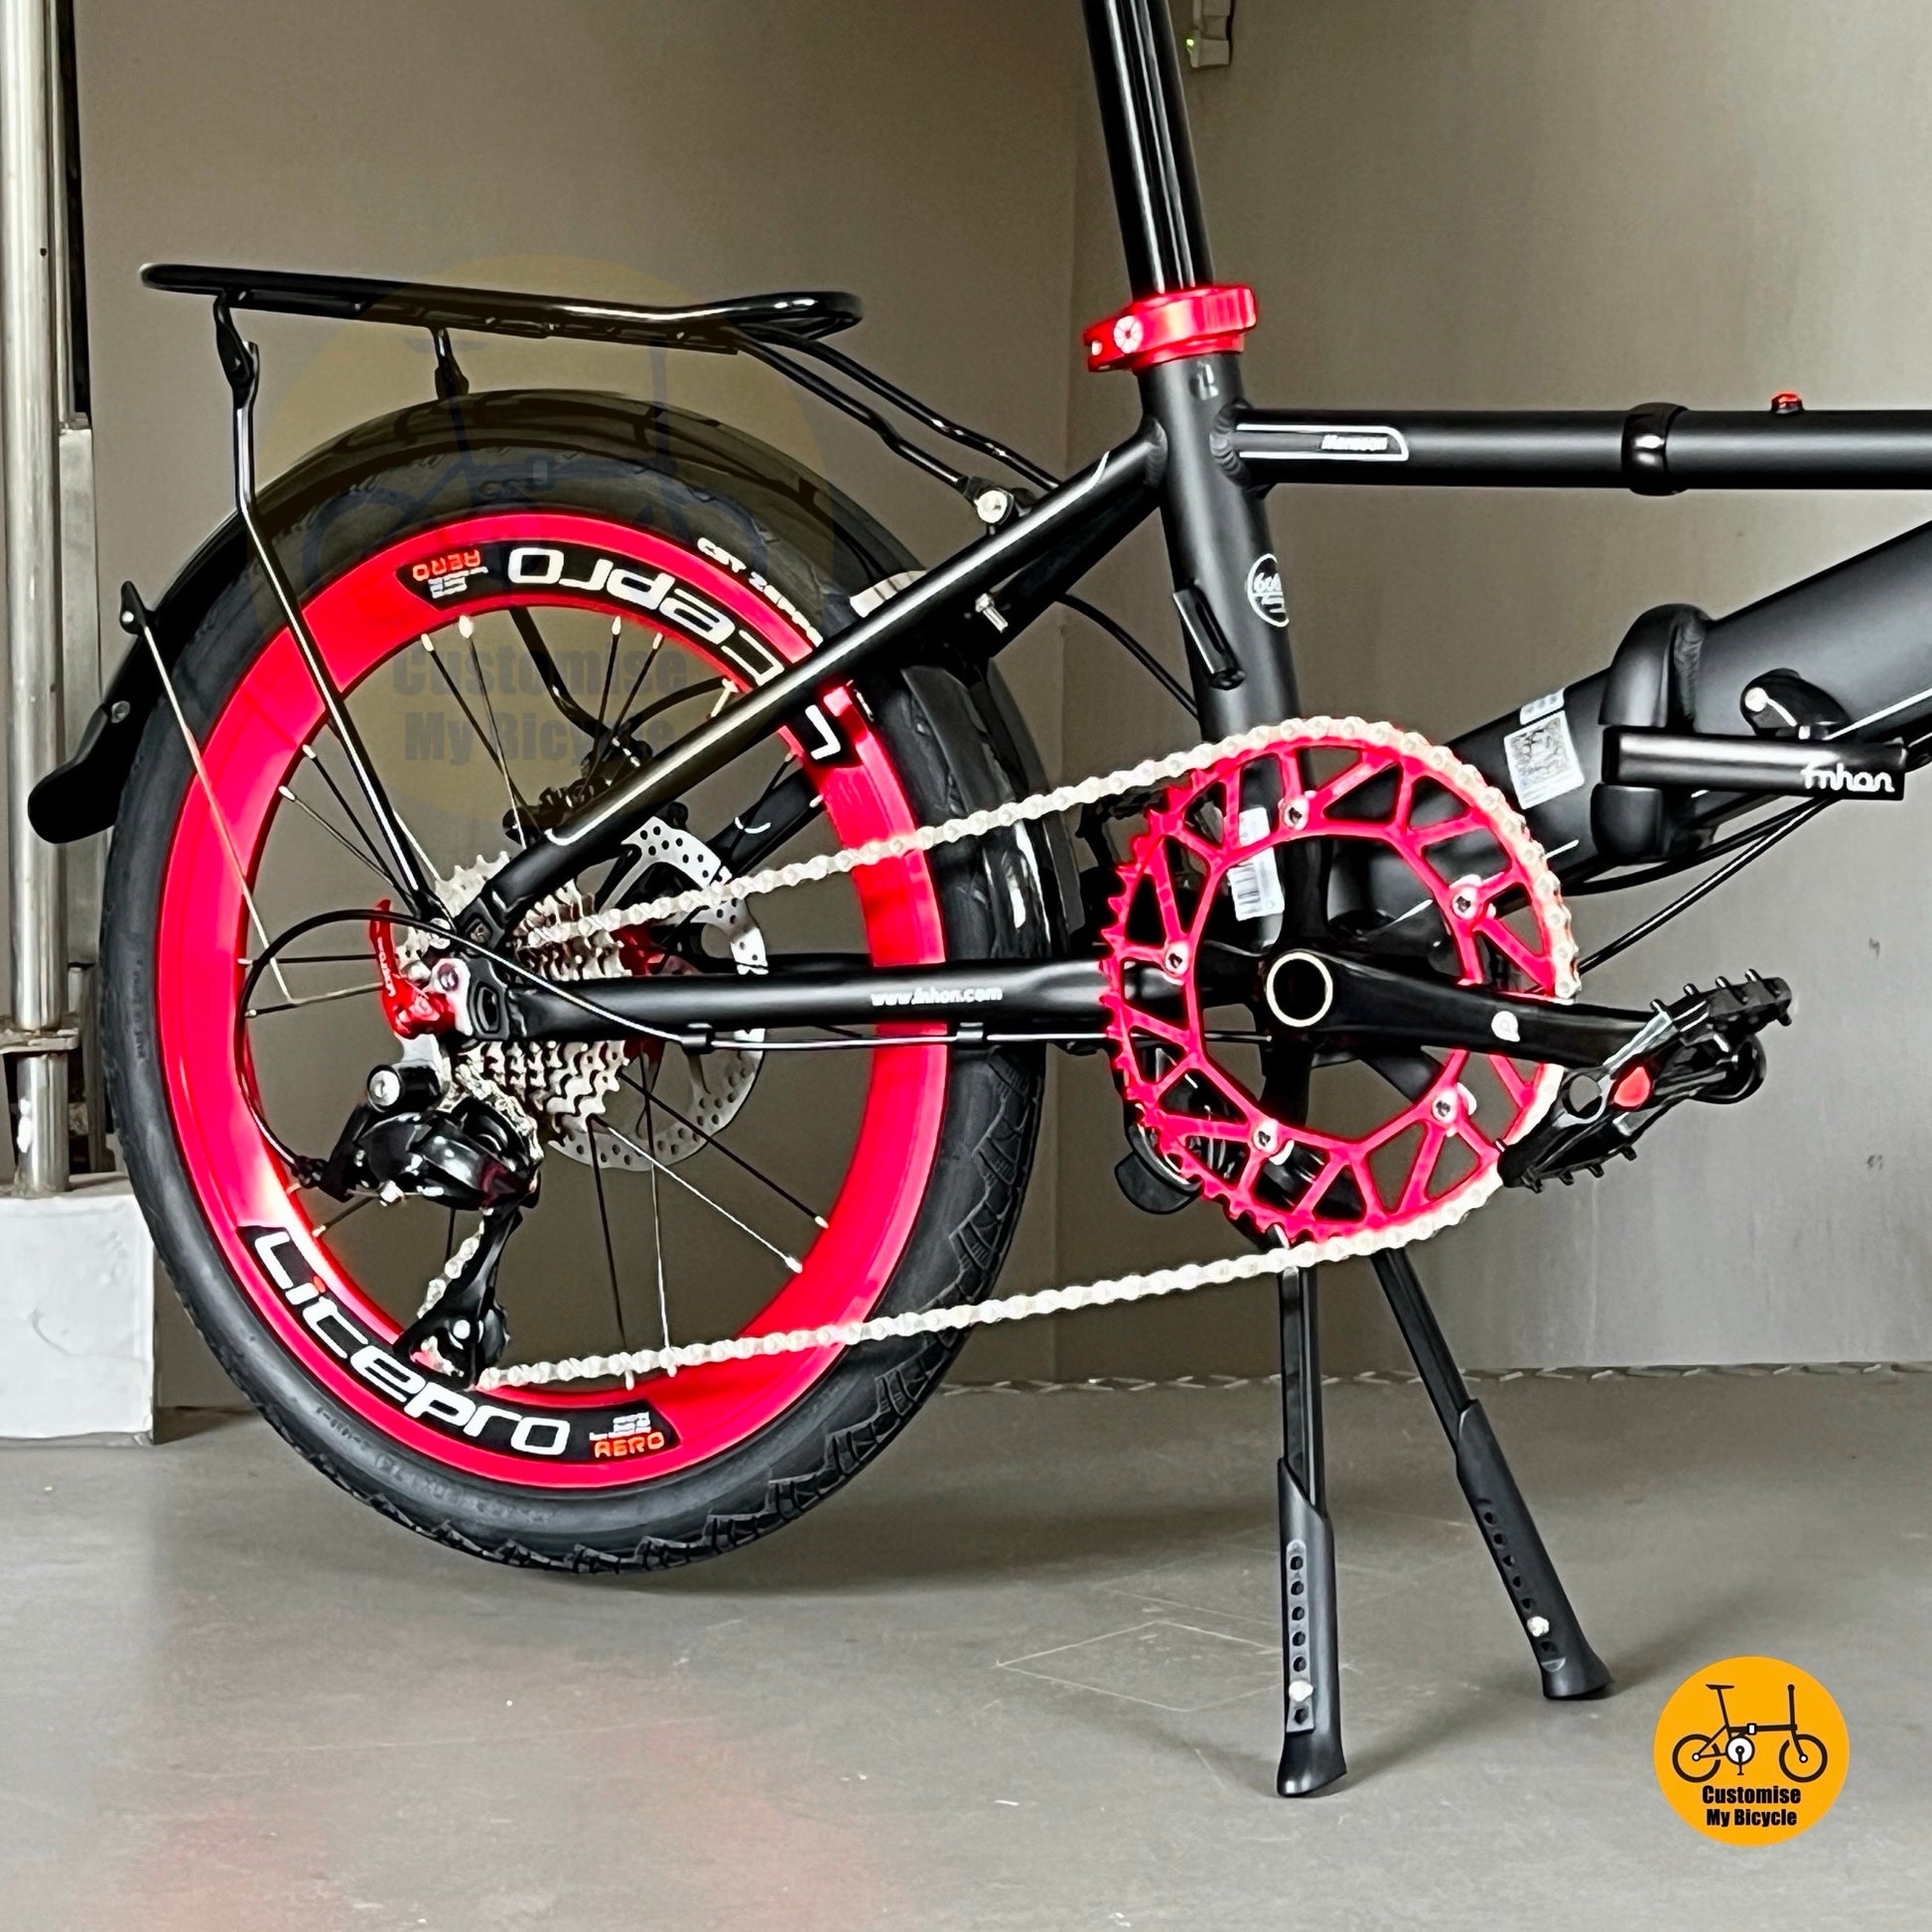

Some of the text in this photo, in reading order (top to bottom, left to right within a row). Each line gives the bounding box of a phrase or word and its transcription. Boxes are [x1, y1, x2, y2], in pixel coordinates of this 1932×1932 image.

[412, 549, 482, 582] AERO
[507, 546, 841, 761] Ltepro
[254, 1231, 571, 1456] Litepro
[594, 1431, 665, 1458] AERO
